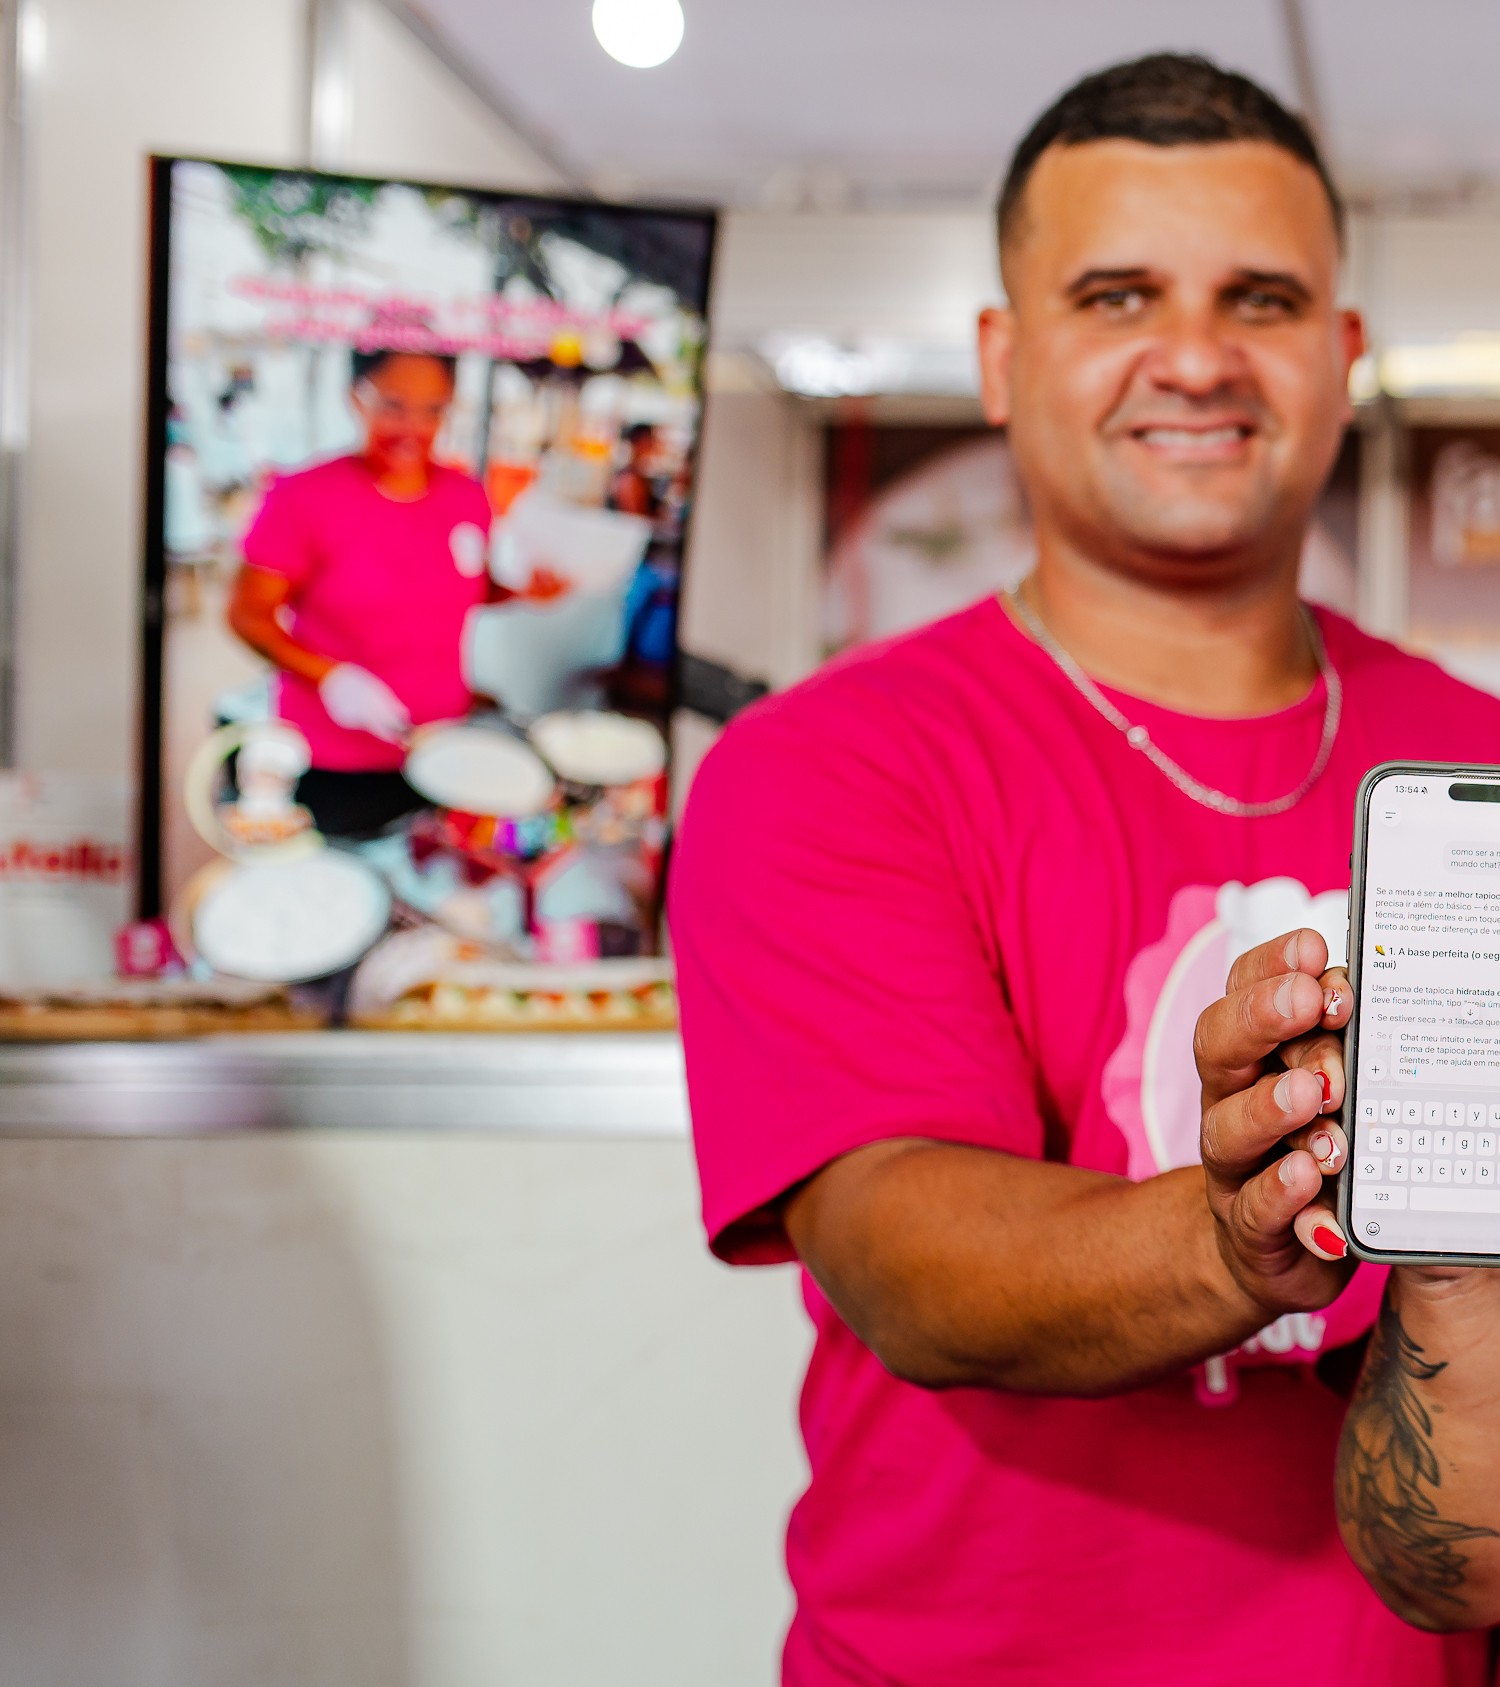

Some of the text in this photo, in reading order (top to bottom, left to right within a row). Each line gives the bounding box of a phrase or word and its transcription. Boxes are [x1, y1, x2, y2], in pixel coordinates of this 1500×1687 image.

[1394, 785, 1418, 794] 13:54
[1450, 860, 1479, 868] mundo
[1416, 888, 1422, 896] é
[1445, 890, 1474, 899] melhor
[1375, 899, 1404, 908] precisa
[1405, 899, 1412, 908] ir
[1413, 900, 1432, 909] além
[1433, 901, 1445, 910] do
[1446, 901, 1472, 911] básico
[1483, 903, 1489, 912] é
[1407, 911, 1456, 922] ingredientes
[1374, 922, 1398, 931] direto
[1427, 924, 1440, 933] faz
[1441, 925, 1478, 936] diferença
[1479, 926, 1491, 935] de
[1389, 947, 1396, 956] 1.
[1398, 947, 1406, 956] A
[1407, 947, 1431, 957] base
[1432, 949, 1469, 959] perfeita
[1471, 950, 1481, 960] (o
[1373, 959, 1397, 970] aqui)
[1413, 985, 1424, 994] de
[1425, 986, 1454, 995] tapioca
[1456, 987, 1495, 997] hidratada
[1371, 995, 1391, 1004] deve
[1392, 996, 1410, 1005] ficar
[1446, 998, 1462, 1008] tipo
[1377, 1013, 1388, 1022] Se
[1389, 1014, 1416, 1023] estiver
[1400, 1033, 1419, 1042] Chat
[1439, 1034, 1465, 1044] intuito
[1473, 1036, 1493, 1044] levar
[1400, 1044, 1423, 1053] forma
[1424, 1045, 1435, 1054] de
[1437, 1046, 1466, 1055] tapioca
[1467, 1048, 1485, 1056] para
[1399, 1055, 1430, 1065] clientes
[1450, 1057, 1472, 1067] ajuda
[1365, 1107, 1373, 1117] q
[1386, 1108, 1396, 1116] w
[1408, 1108, 1416, 1117] e
[1431, 1109, 1436, 1117] r
[1453, 1109, 1458, 1118] t
[1473, 1111, 1480, 1122] y
[1375, 1136, 1382, 1144] a
[1397, 1136, 1403, 1145] s
[1418, 1135, 1425, 1146] d
[1441, 1136, 1446, 1146] f
[1461, 1139, 1468, 1150] g
[1482, 1138, 1490, 1148] h
[1396, 1165, 1402, 1174] z
[1417, 1166, 1424, 1174] x
[1439, 1167, 1446, 1175] c
[1460, 1168, 1467, 1176] v
[1481, 1166, 1489, 1177] b
[1374, 1192, 1390, 1201] 123
